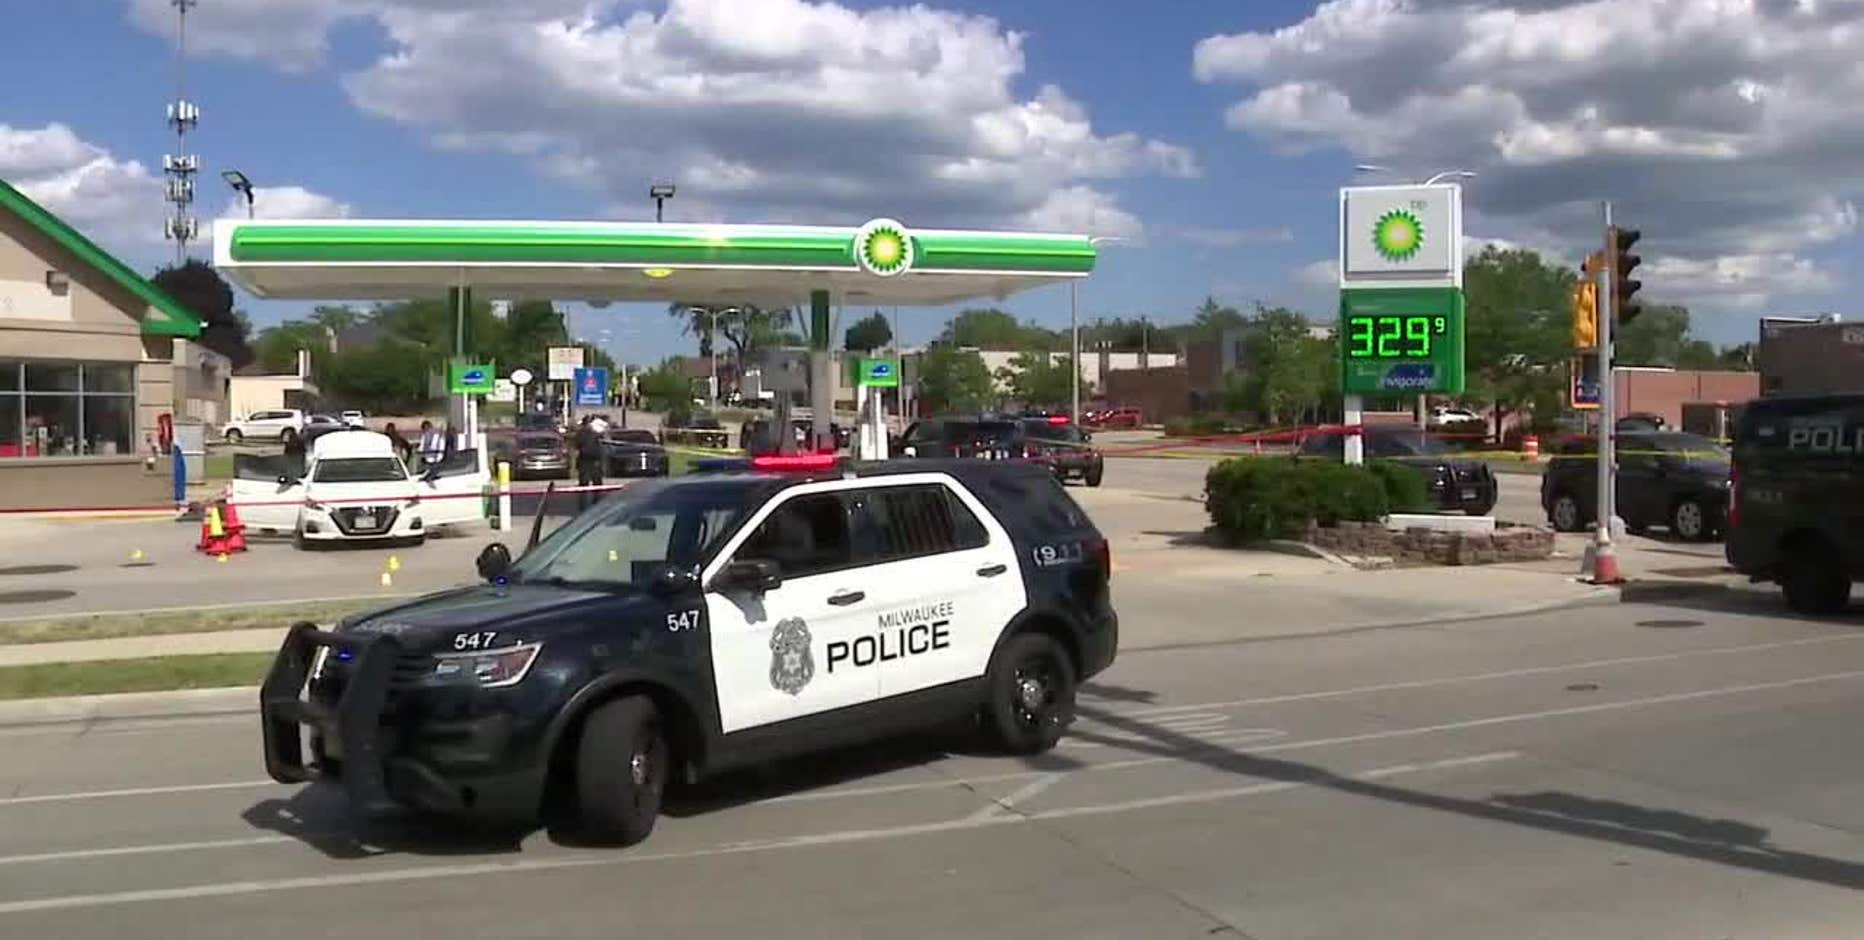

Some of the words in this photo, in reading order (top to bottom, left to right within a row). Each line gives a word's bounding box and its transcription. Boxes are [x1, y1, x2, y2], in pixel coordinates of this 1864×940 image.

[1351, 317, 1430, 356] 329
[667, 610, 700, 632] 547
[878, 602, 955, 629] MILWAUKEE
[454, 631, 497, 650] 547
[827, 620, 951, 673] POLICE
